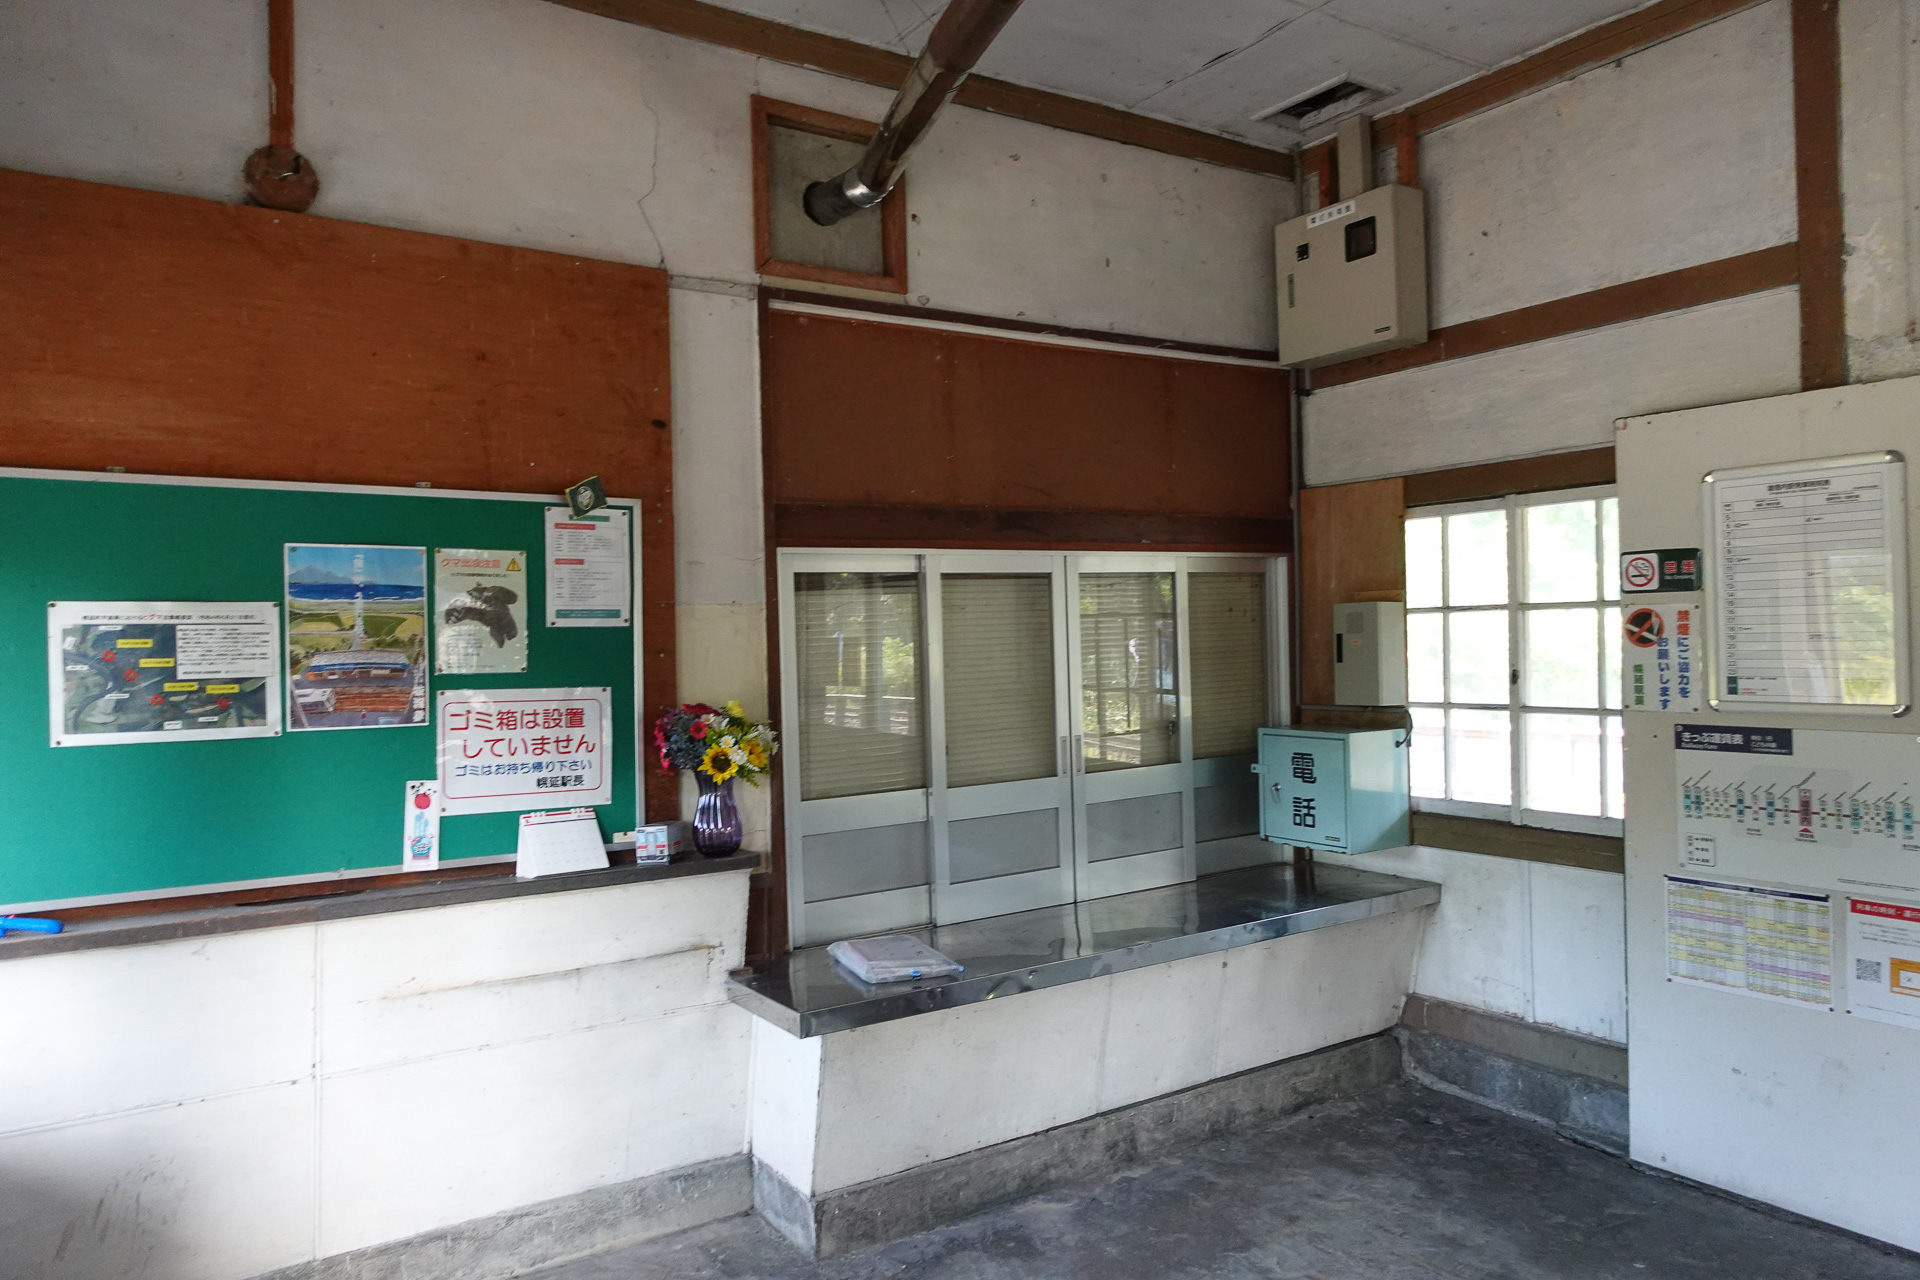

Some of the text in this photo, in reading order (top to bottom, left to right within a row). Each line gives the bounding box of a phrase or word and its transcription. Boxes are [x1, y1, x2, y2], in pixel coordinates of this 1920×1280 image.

[1677, 609, 1691, 699] 禁煙にご協力を
[1657, 637, 1671, 710] お願いします
[449, 707, 586, 731] ゴミ箱は設置
[463, 734, 596, 759] していません
[455, 759, 593, 777] ゴミはお持ち帰り下さい
[536, 775, 585, 789] 幌延駅長
[1291, 751, 1317, 829] 電話
